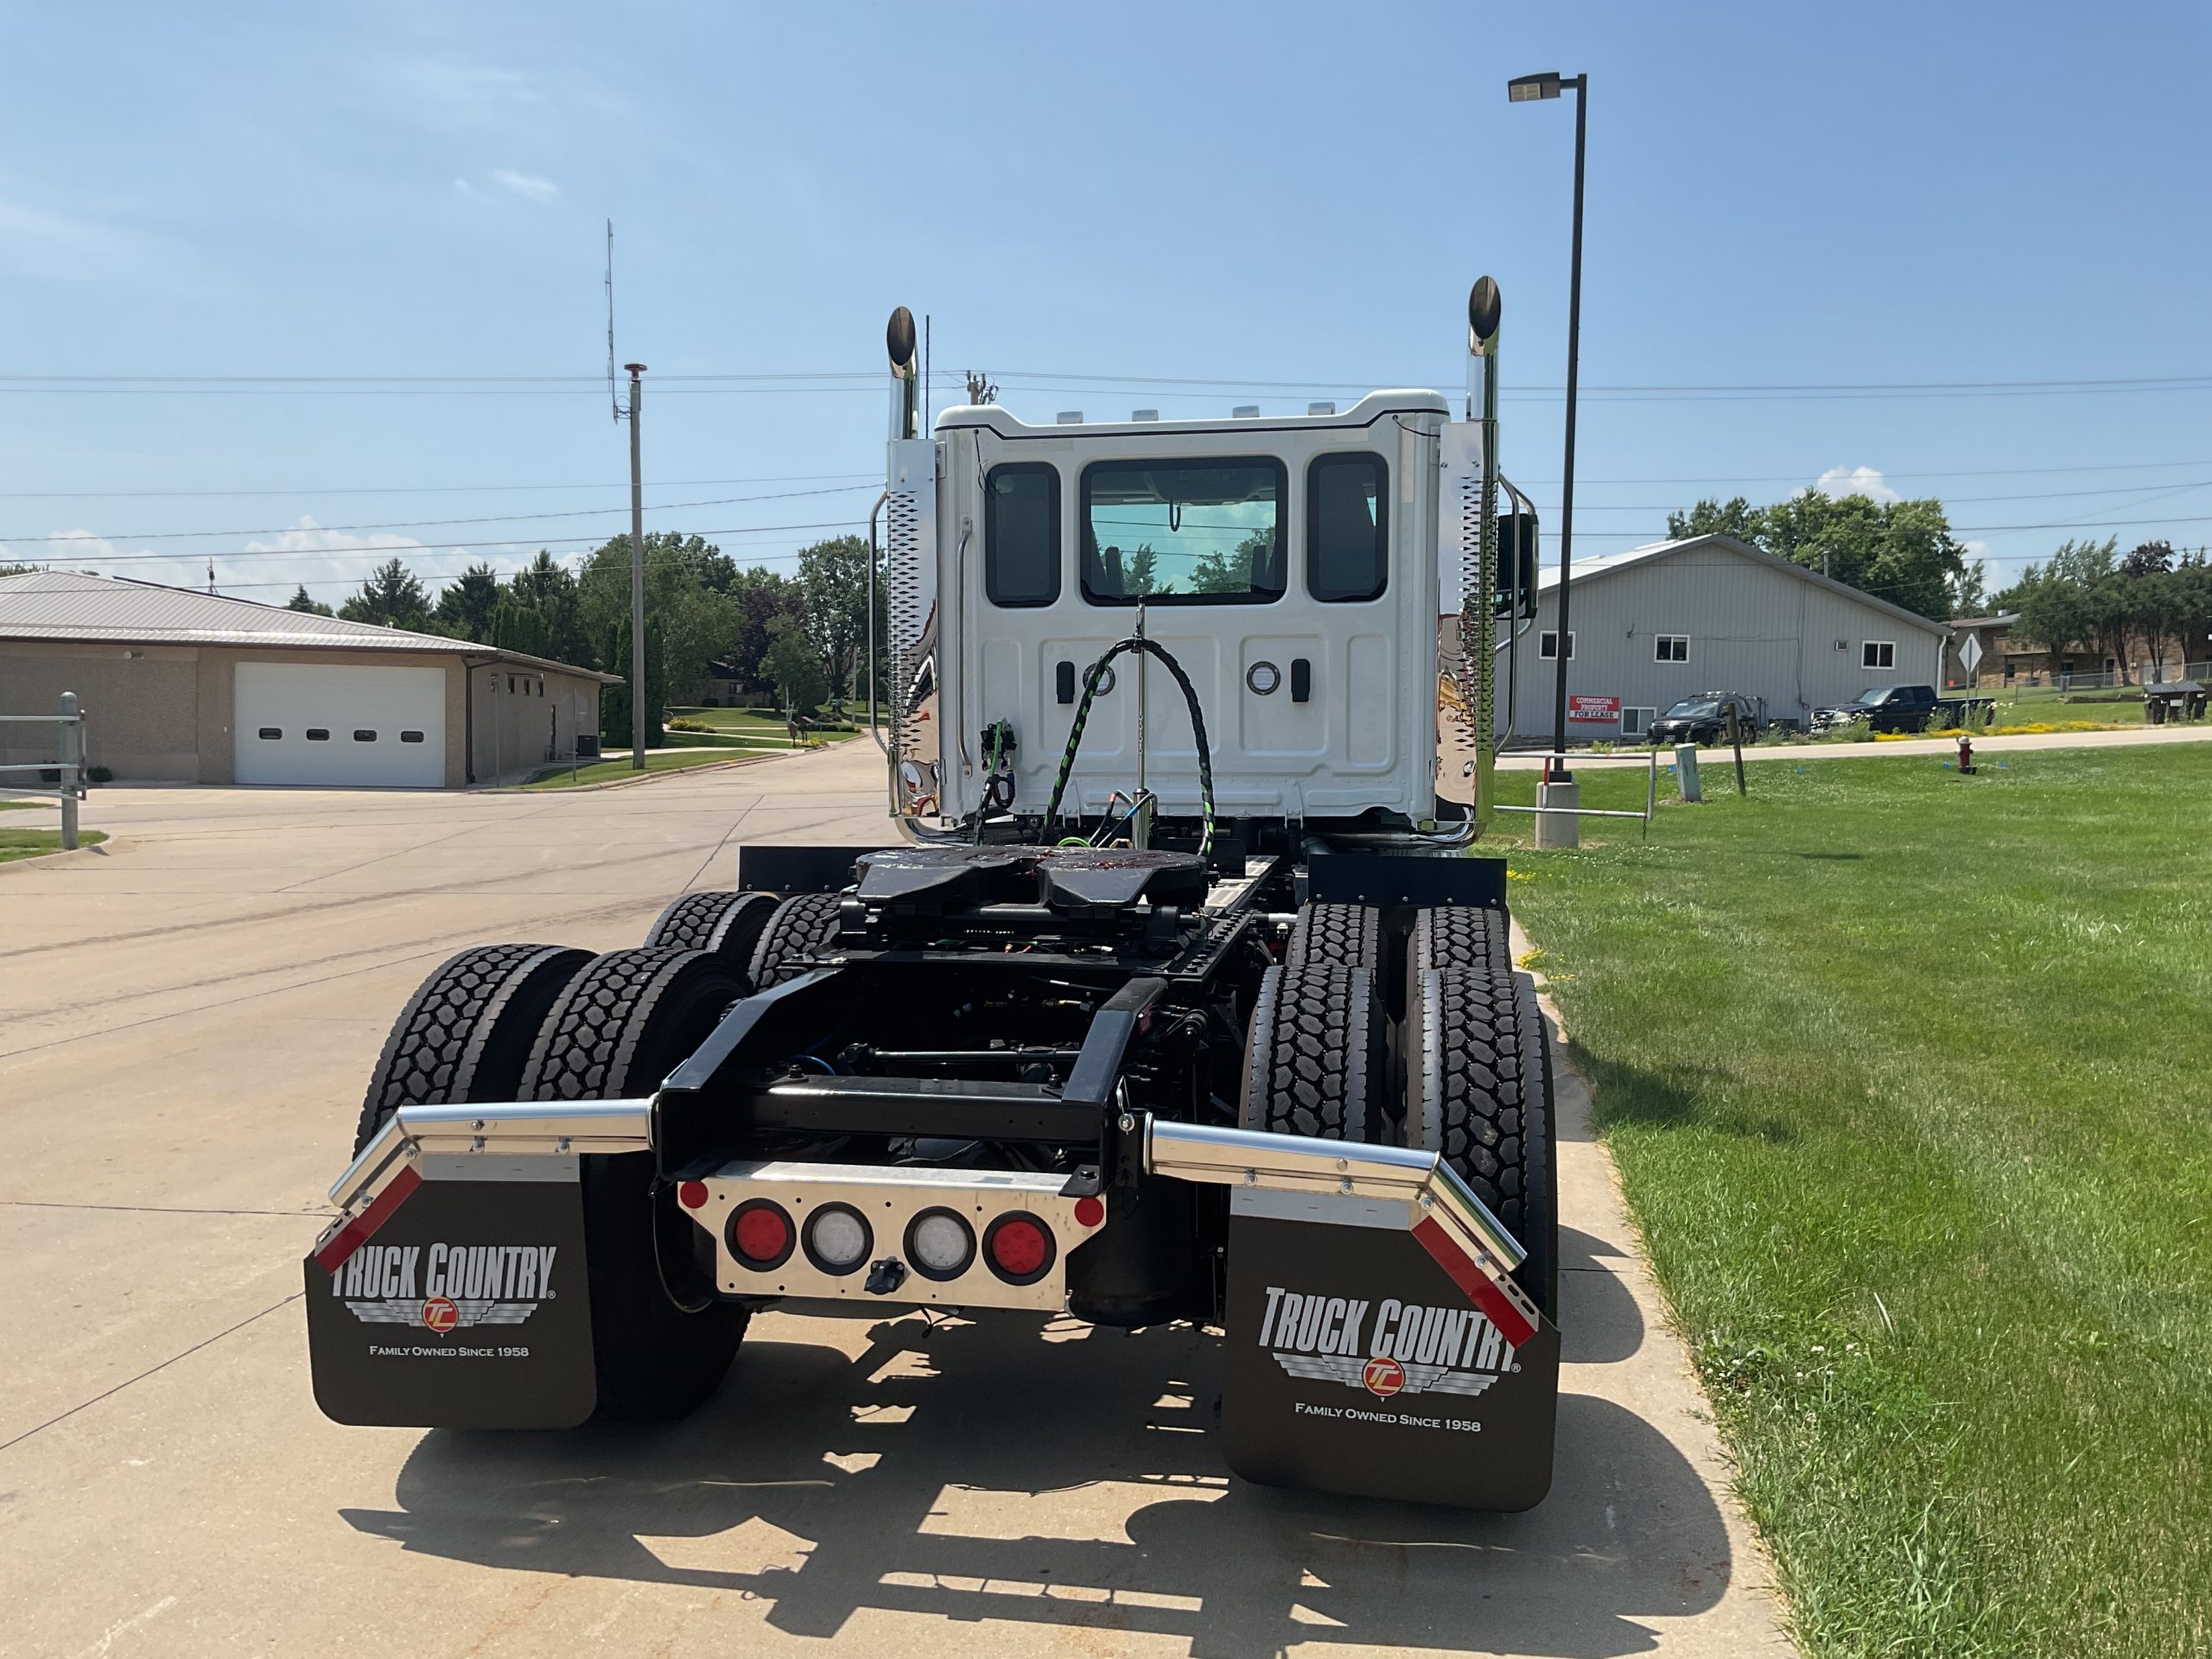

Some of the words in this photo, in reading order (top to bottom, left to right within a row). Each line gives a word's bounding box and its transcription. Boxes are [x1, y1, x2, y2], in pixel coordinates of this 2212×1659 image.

[1258, 1286, 1370, 1357] TRUCK
[369, 1345, 410, 1357] FAMILY
[411, 1346, 457, 1357] OWNED
[458, 1346, 495, 1357] SINCE
[498, 1347, 530, 1357] 1958
[1294, 1402, 1344, 1419] FAMILY
[1344, 1408, 1398, 1423] OWNED
[1398, 1414, 1441, 1428] SINCE
[1445, 1419, 1482, 1433] 1958
